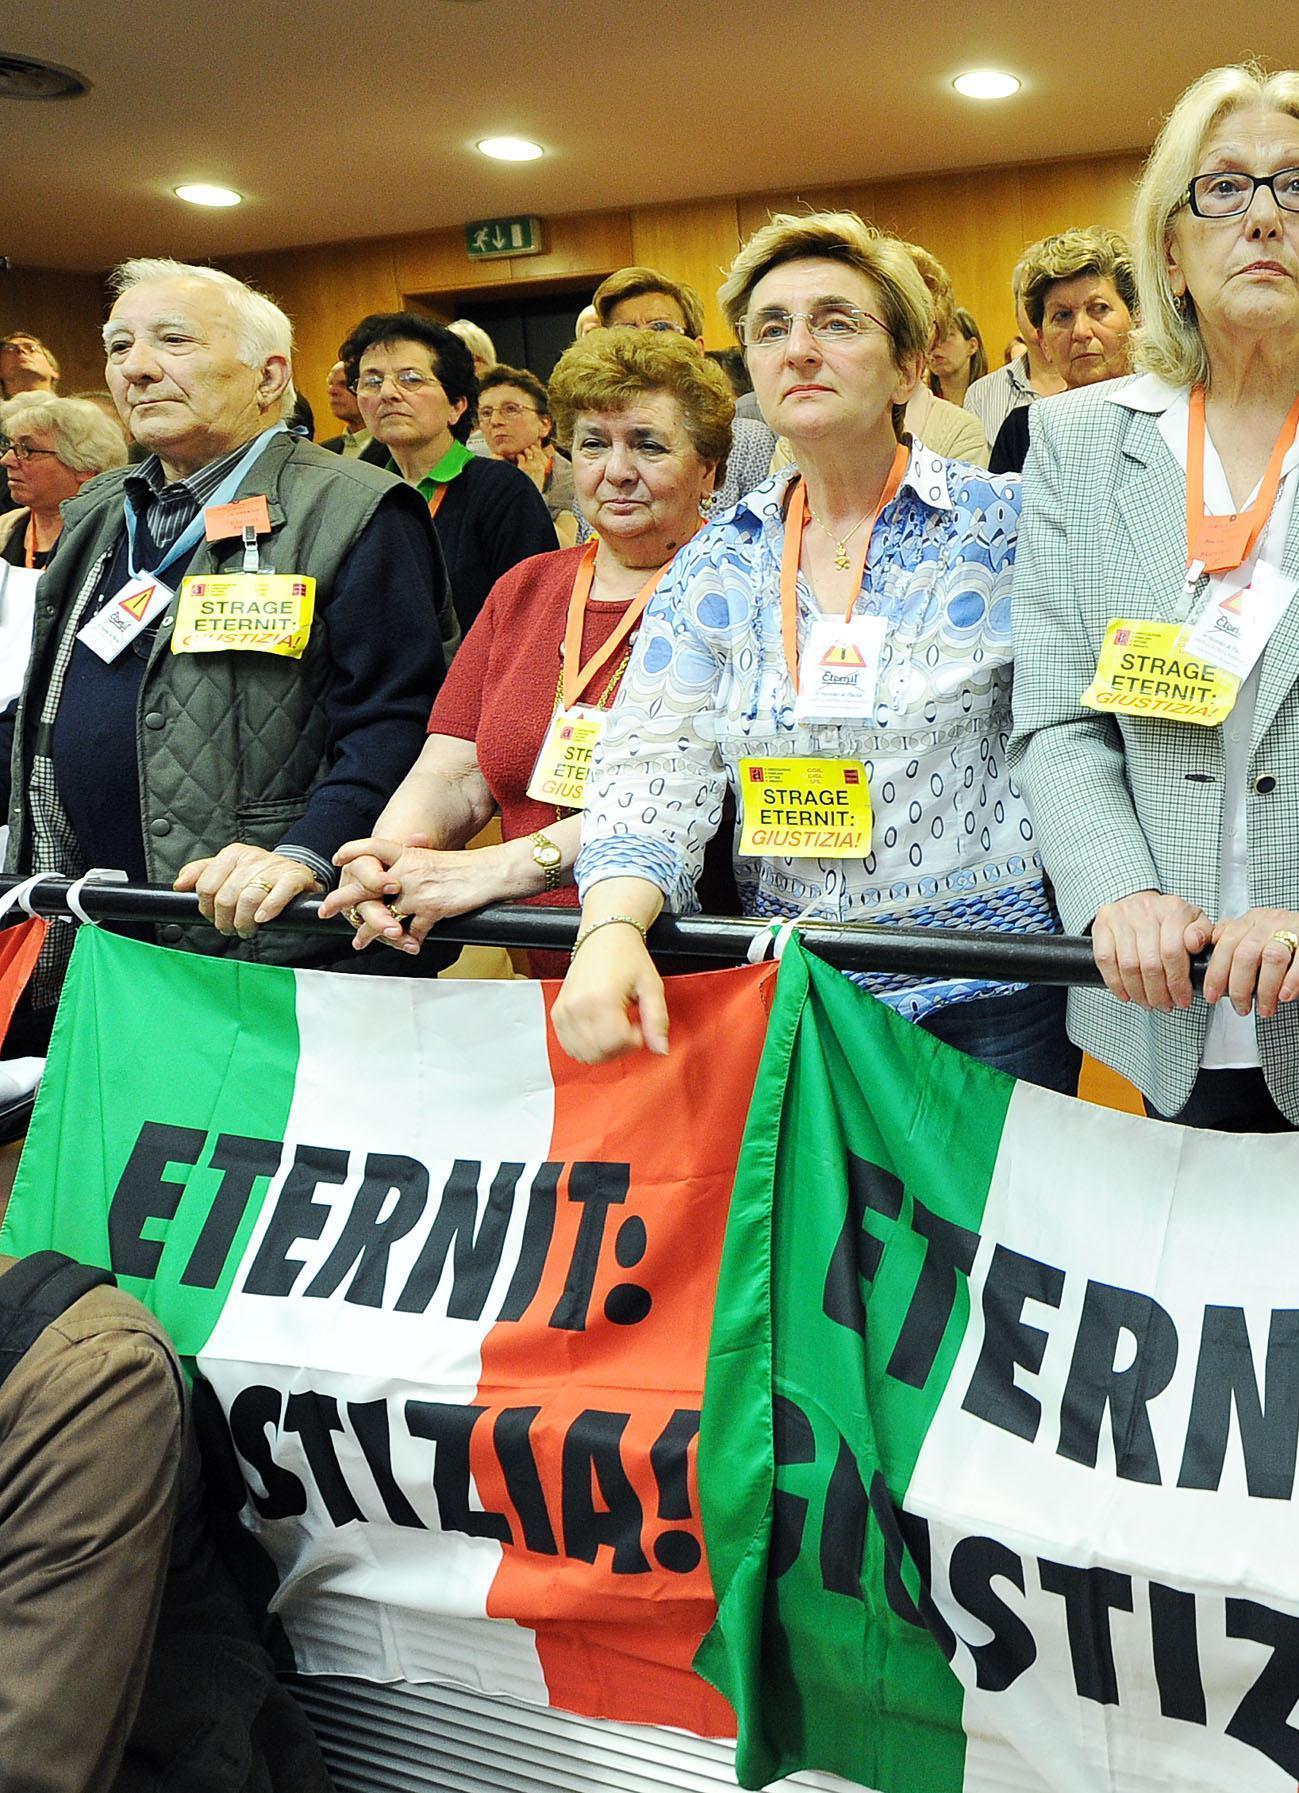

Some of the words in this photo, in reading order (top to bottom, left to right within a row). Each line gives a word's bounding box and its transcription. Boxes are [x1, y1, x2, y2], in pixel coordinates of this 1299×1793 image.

[200, 601, 294, 614] STRAGE
[194, 618, 297, 631] ETERNIT:
[1119, 653, 1217, 683] STRAGE
[1110, 674, 1217, 704] ETERNIT:
[1096, 692, 1220, 718] GIUSTIZIA!
[763, 789, 849, 805] STRAGE
[760, 809, 855, 827] ETERNIT:
[751, 829, 862, 848] GIUSTIZIA!
[107, 1120, 653, 1332] ETERNIT:
